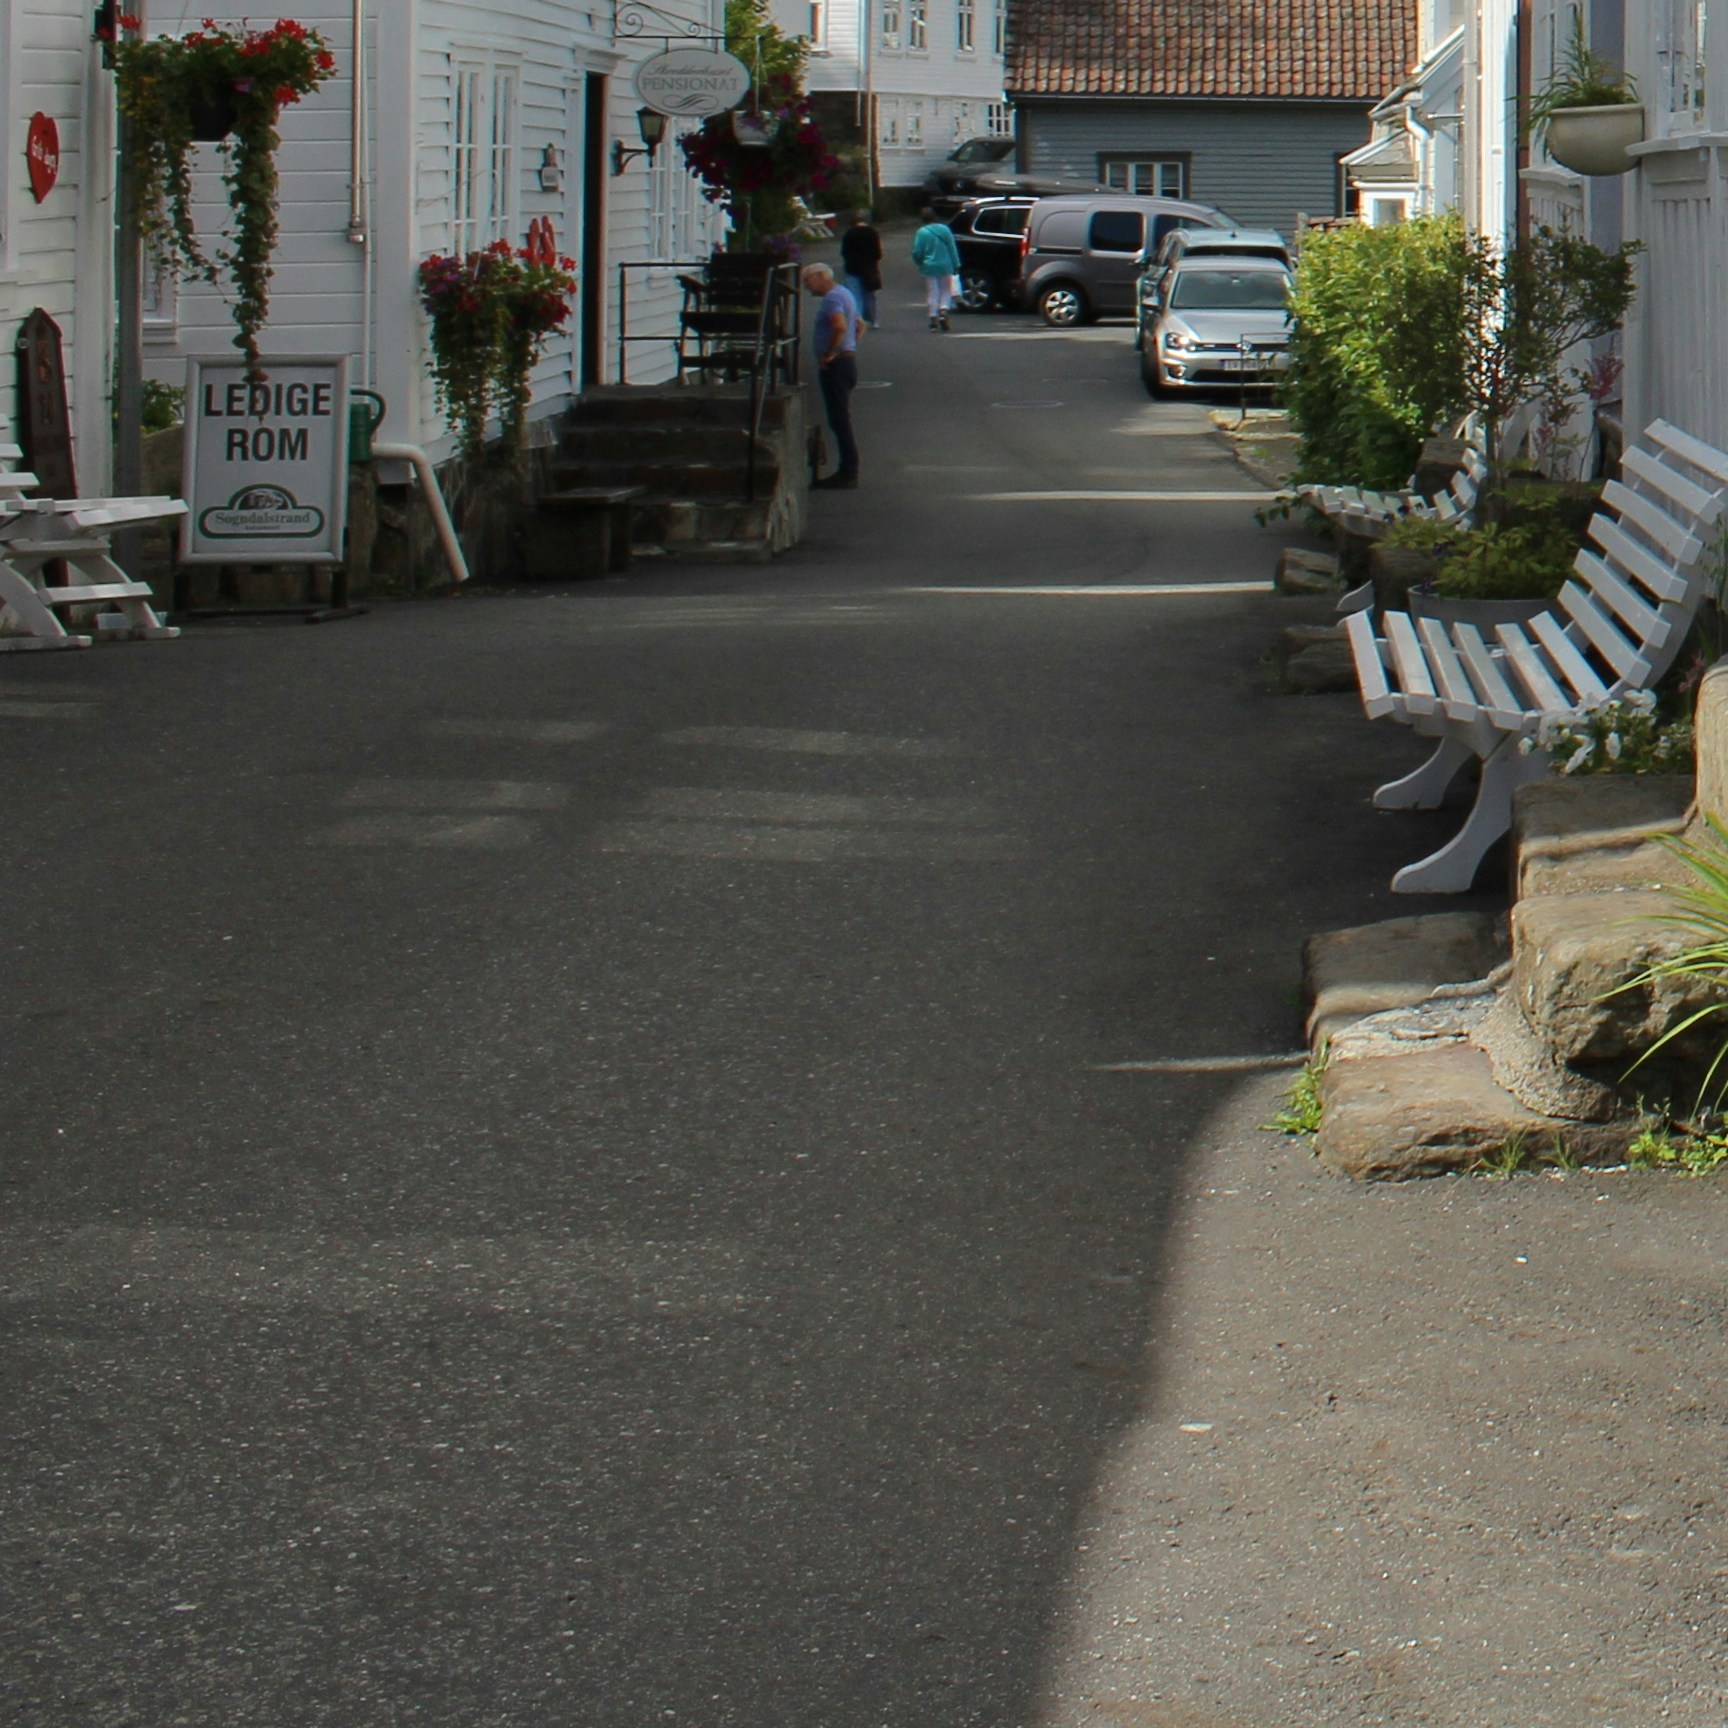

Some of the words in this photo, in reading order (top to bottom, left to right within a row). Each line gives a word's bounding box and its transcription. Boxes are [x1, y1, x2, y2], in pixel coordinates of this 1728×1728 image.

[642, 77, 736, 89] PENSIONAT
[203, 382, 331, 416] LEDIGE
[225, 426, 309, 461] ROM
